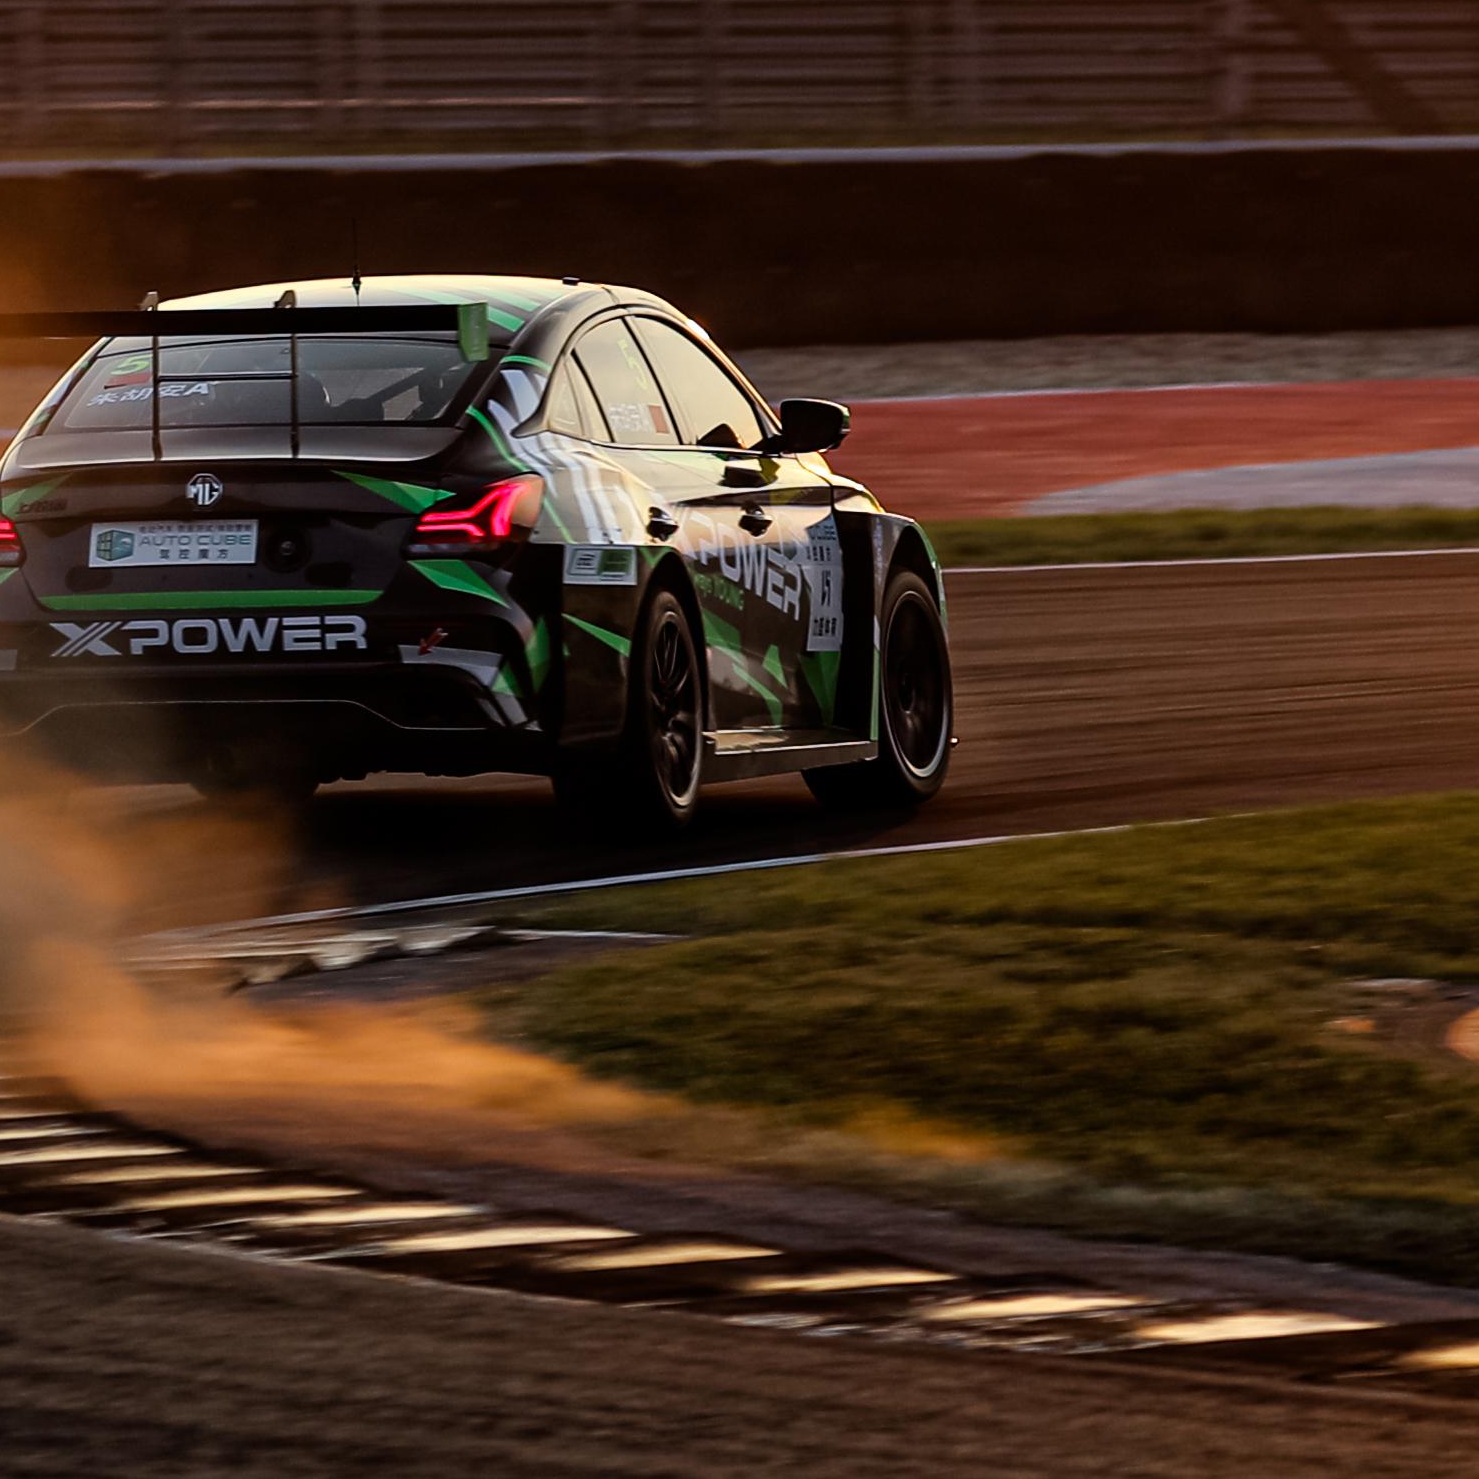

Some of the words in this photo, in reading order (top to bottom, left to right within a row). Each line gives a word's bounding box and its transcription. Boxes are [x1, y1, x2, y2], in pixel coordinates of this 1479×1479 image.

[186, 478, 223, 506] MG
[139, 534, 191, 546] AUTO
[196, 534, 252, 546] CUBE
[48, 614, 368, 658] XPOWER
